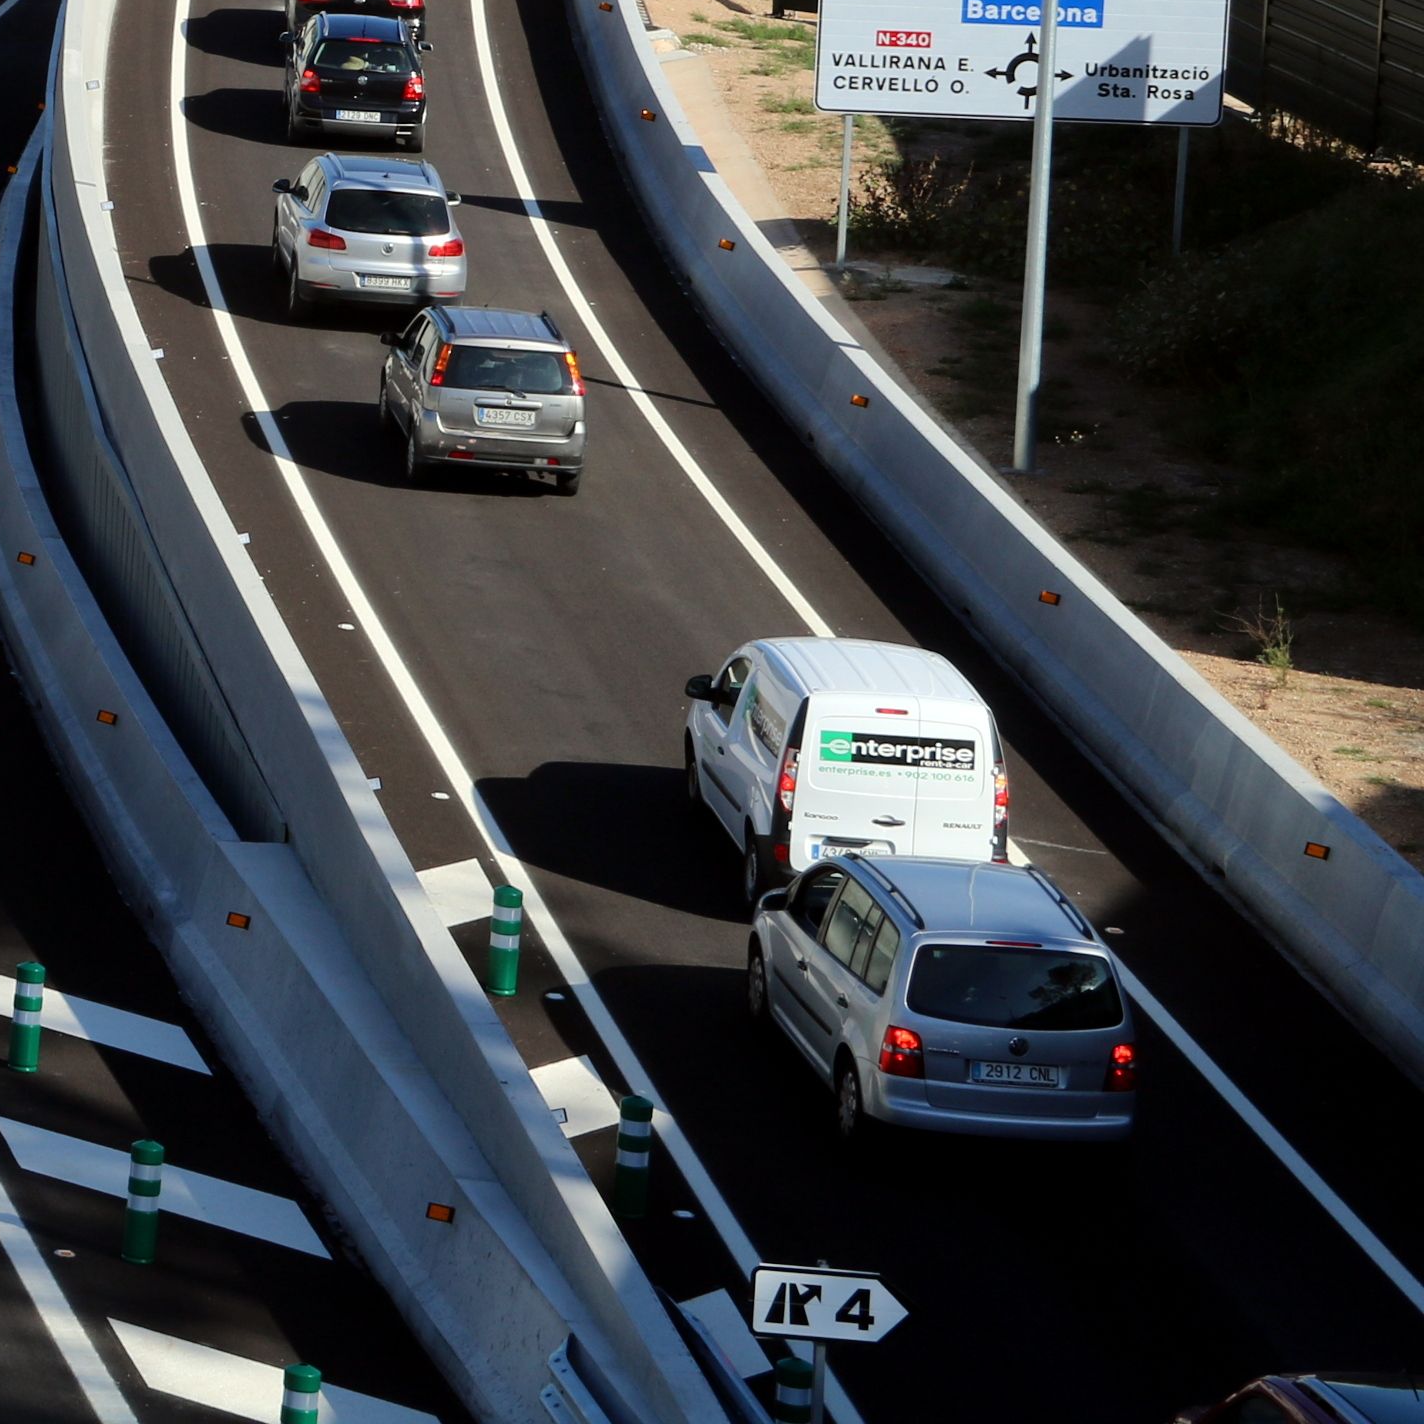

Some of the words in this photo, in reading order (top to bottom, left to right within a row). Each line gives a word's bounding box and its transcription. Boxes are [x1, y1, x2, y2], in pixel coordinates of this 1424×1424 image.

[967, 0, 1098, 23] Barceona
[877, 32, 930, 47] N-340
[832, 53, 947, 71] VALLIRANA
[958, 58, 974, 72] E.
[1085, 62, 1210, 81] Urbanització
[833, 75, 939, 93] CERVELLÓ
[950, 79, 970, 94] O.
[1097, 83, 1136, 99] Sta.
[1147, 85, 1195, 101] Rosa
[485, 410, 511, 421] 4357
[513, 412, 533, 422] CSX
[826, 738, 974, 763] enterprise
[818, 765, 892, 778] enterprise.es
[905, 770, 928, 780] 902
[932, 772, 952, 782] 100
[954, 774, 975, 783] 616
[920, 760, 973, 770] rent-a-car
[942, 822, 983, 830] RENAULT
[985, 1063, 1022, 1080] 2912
[1029, 1066, 1055, 1082] CNL
[835, 1288, 875, 1331] 4
